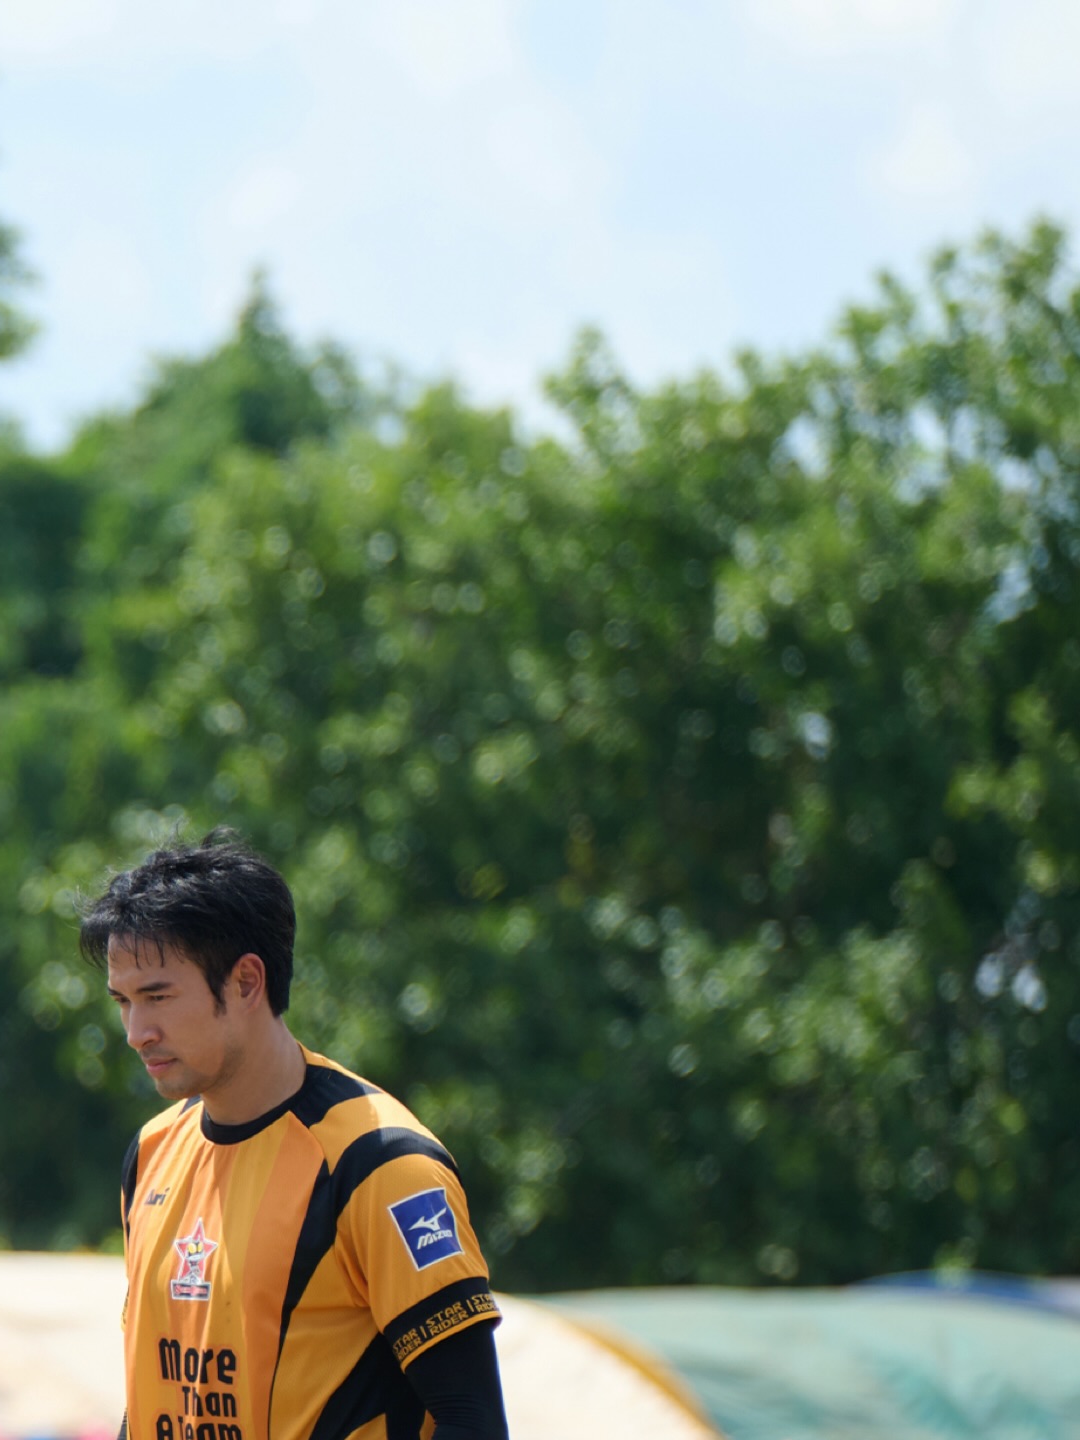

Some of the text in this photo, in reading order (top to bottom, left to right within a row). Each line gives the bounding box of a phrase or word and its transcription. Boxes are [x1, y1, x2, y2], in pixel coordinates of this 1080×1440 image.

[144, 1187, 171, 1206] Ari
[426, 1301, 463, 1329] STAR
[429, 1310, 469, 1336] RIDER
[393, 1328, 418, 1354] STAR
[159, 1338, 236, 1385] More
[182, 1386, 237, 1417] Than
